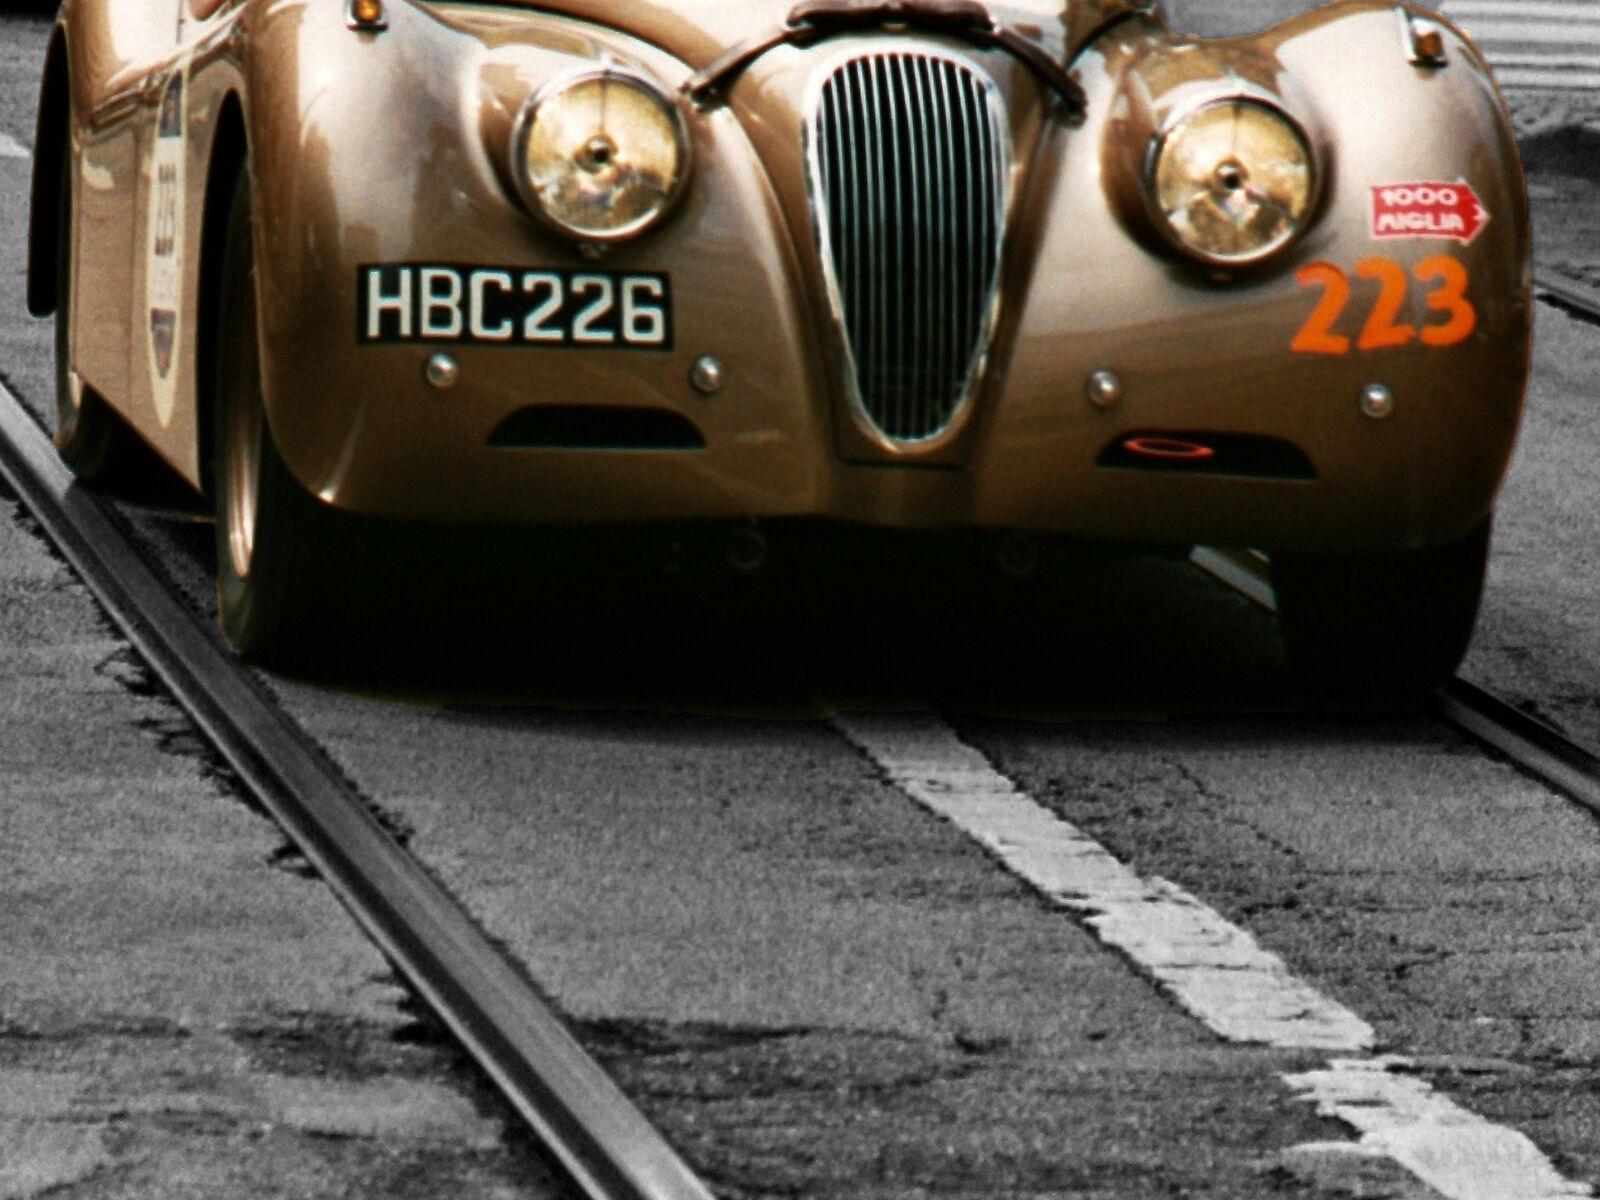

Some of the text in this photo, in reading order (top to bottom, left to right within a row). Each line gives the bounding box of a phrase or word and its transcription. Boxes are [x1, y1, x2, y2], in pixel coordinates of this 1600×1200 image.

[1380, 187, 1458, 206] 1000
[1379, 212, 1464, 232] MIGLIA
[368, 267, 665, 343] HBC226
[1290, 252, 1475, 355] 223
